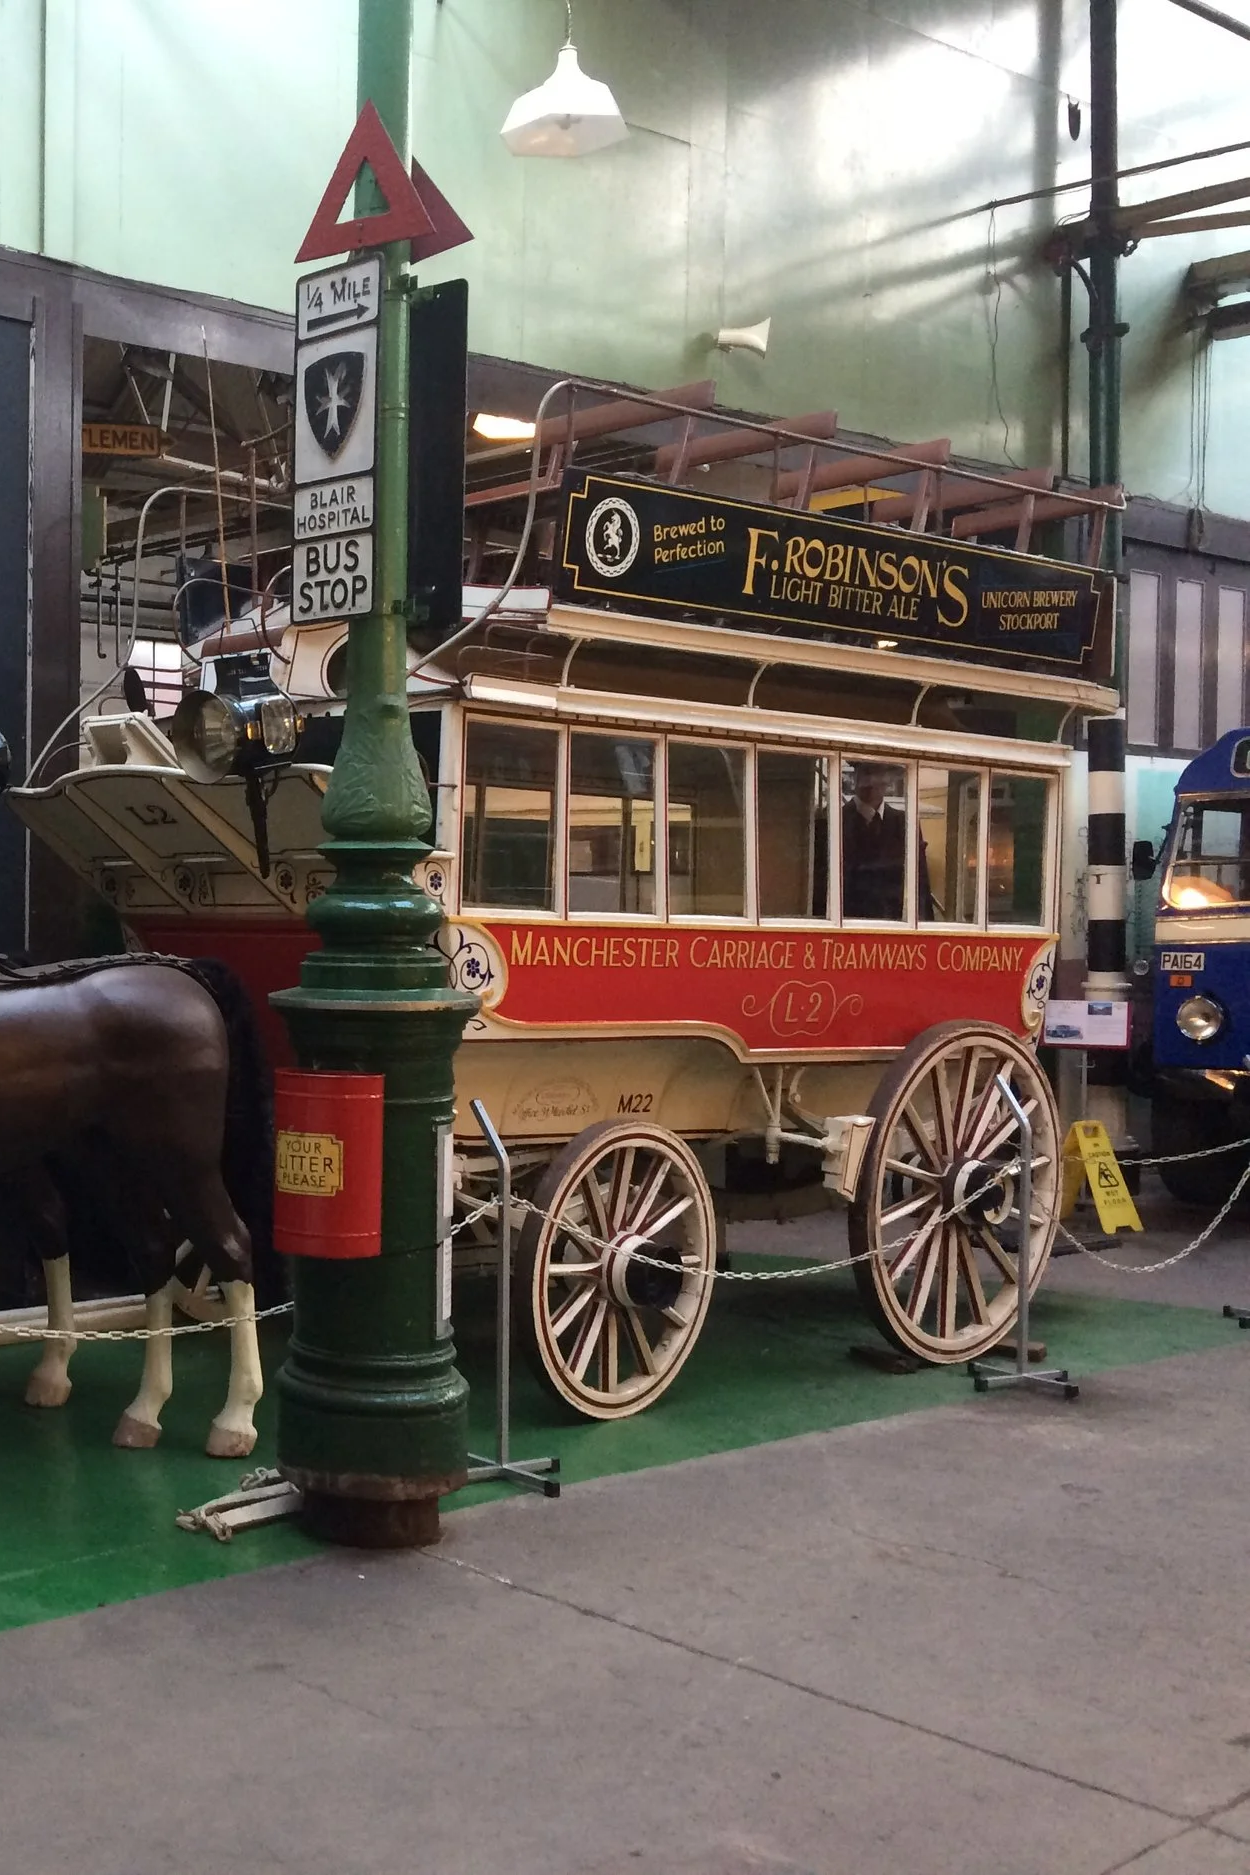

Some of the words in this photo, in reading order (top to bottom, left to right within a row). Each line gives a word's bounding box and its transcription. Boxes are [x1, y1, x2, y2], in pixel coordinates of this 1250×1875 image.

[331, 276, 370, 306] MILE
[310, 485, 356, 510] BLAIR
[297, 505, 370, 534] HOSPITAL
[653, 519, 706, 542] Brewed
[710, 515, 726, 532] to
[306, 539, 359, 577] BUS
[654, 539, 725, 564] Perfection
[299, 575, 367, 614] STOP
[770, 575, 823, 605] LIGHT
[828, 585, 882, 615] BITTER
[887, 595, 920, 621] ALE
[981, 591, 1030, 609] UNICORN
[1032, 590, 1078, 607] BREWERY
[999, 612, 1059, 630] STOCKPORT
[510, 931, 679, 968] MANCHESTER
[690, 937, 797, 969] CARRIAGE
[803, 941, 816, 969] &
[822, 938, 927, 970] TRAMWAYS
[617, 1093, 654, 1114] M22
[285, 1140, 322, 1154] YOUR
[279, 1154, 334, 1173] LITTER
[282, 1171, 326, 1188] PLEASE
